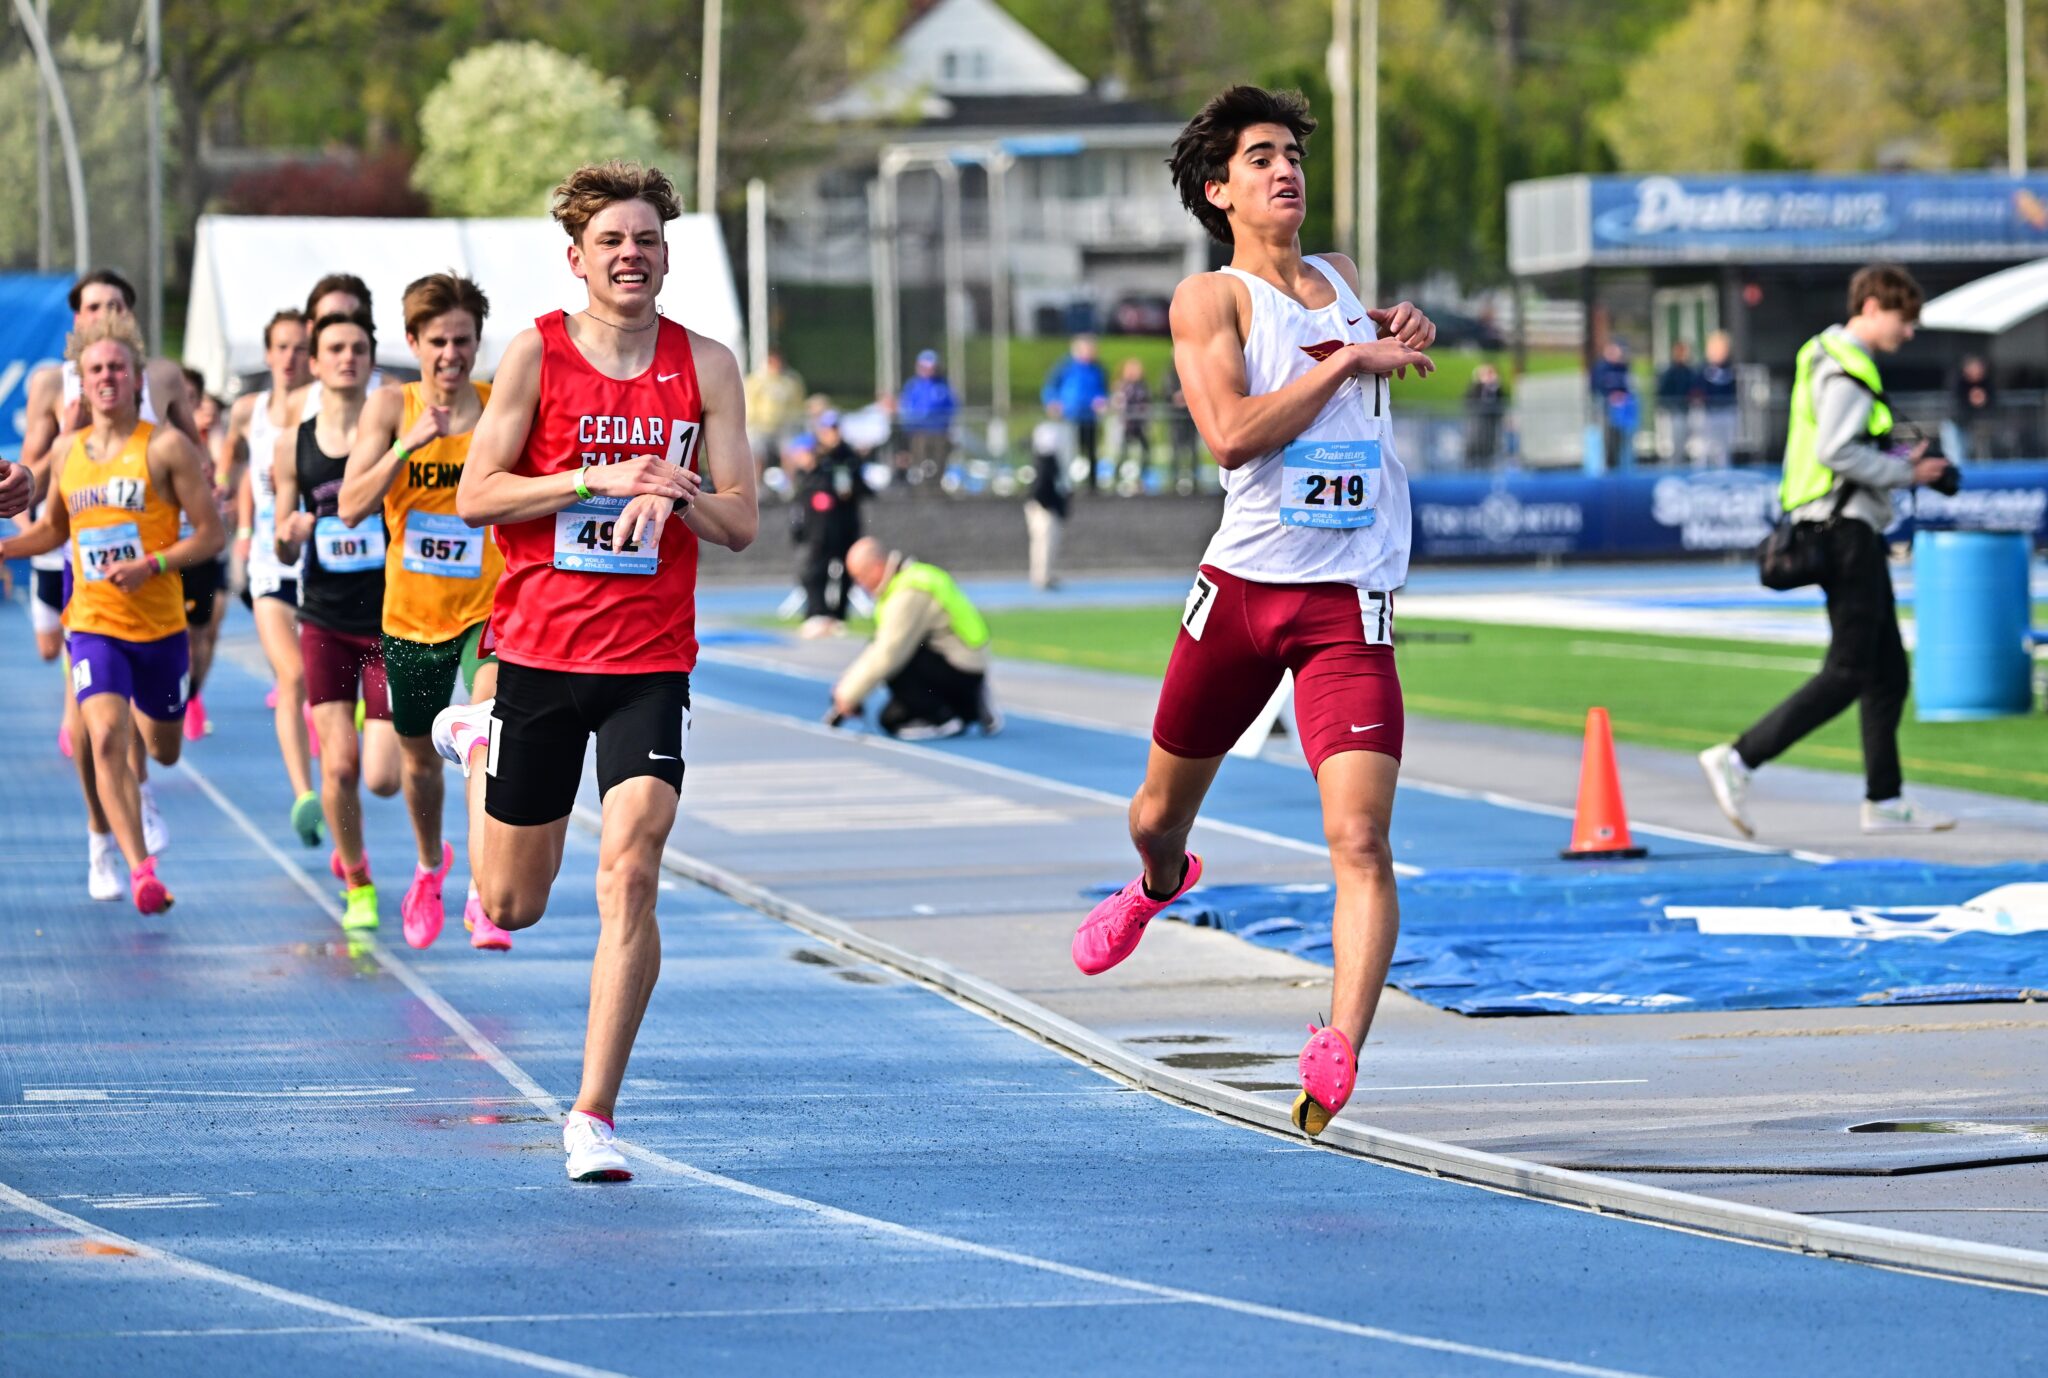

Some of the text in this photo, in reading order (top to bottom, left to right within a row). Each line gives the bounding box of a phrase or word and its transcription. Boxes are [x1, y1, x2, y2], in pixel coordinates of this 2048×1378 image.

[1636, 176, 1771, 233] Drake
[579, 415, 665, 446] CEDAR
[680, 426, 694, 468] 1
[1313, 448, 1344, 460] Drake
[116, 479, 139, 507] 12
[1304, 474, 1364, 507] 219
[332, 539, 367, 555] 801
[420, 537, 467, 561] 657
[1186, 577, 1212, 626] 7
[1368, 592, 1386, 642] 7
